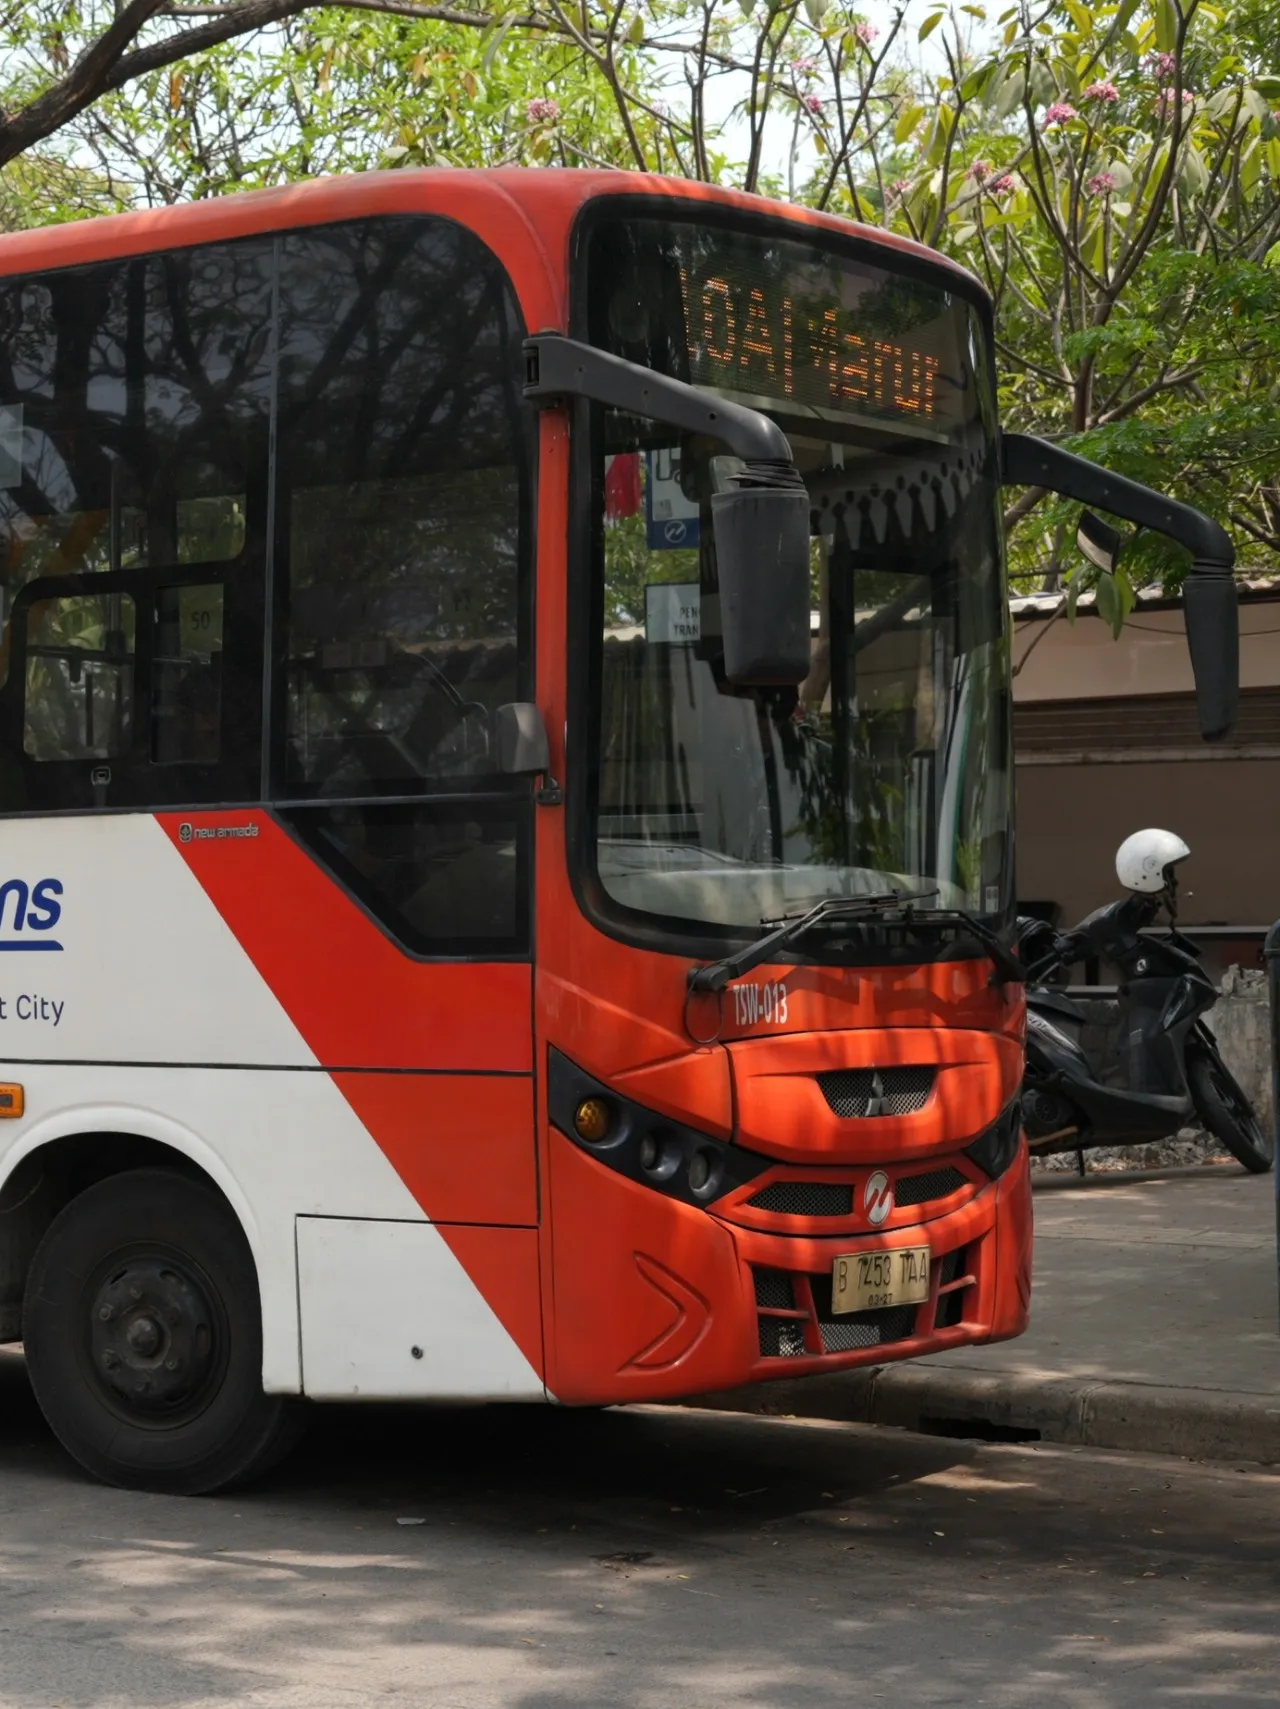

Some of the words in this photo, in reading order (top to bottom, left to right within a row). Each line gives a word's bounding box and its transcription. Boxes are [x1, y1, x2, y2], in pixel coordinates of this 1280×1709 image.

[680, 606, 701, 619] PEN
[194, 827, 216, 839] new
[217, 822, 259, 837] armada
[16, 994, 64, 1027] City
[733, 983, 788, 1026] TSW-013
[839, 1260, 848, 1293] B
